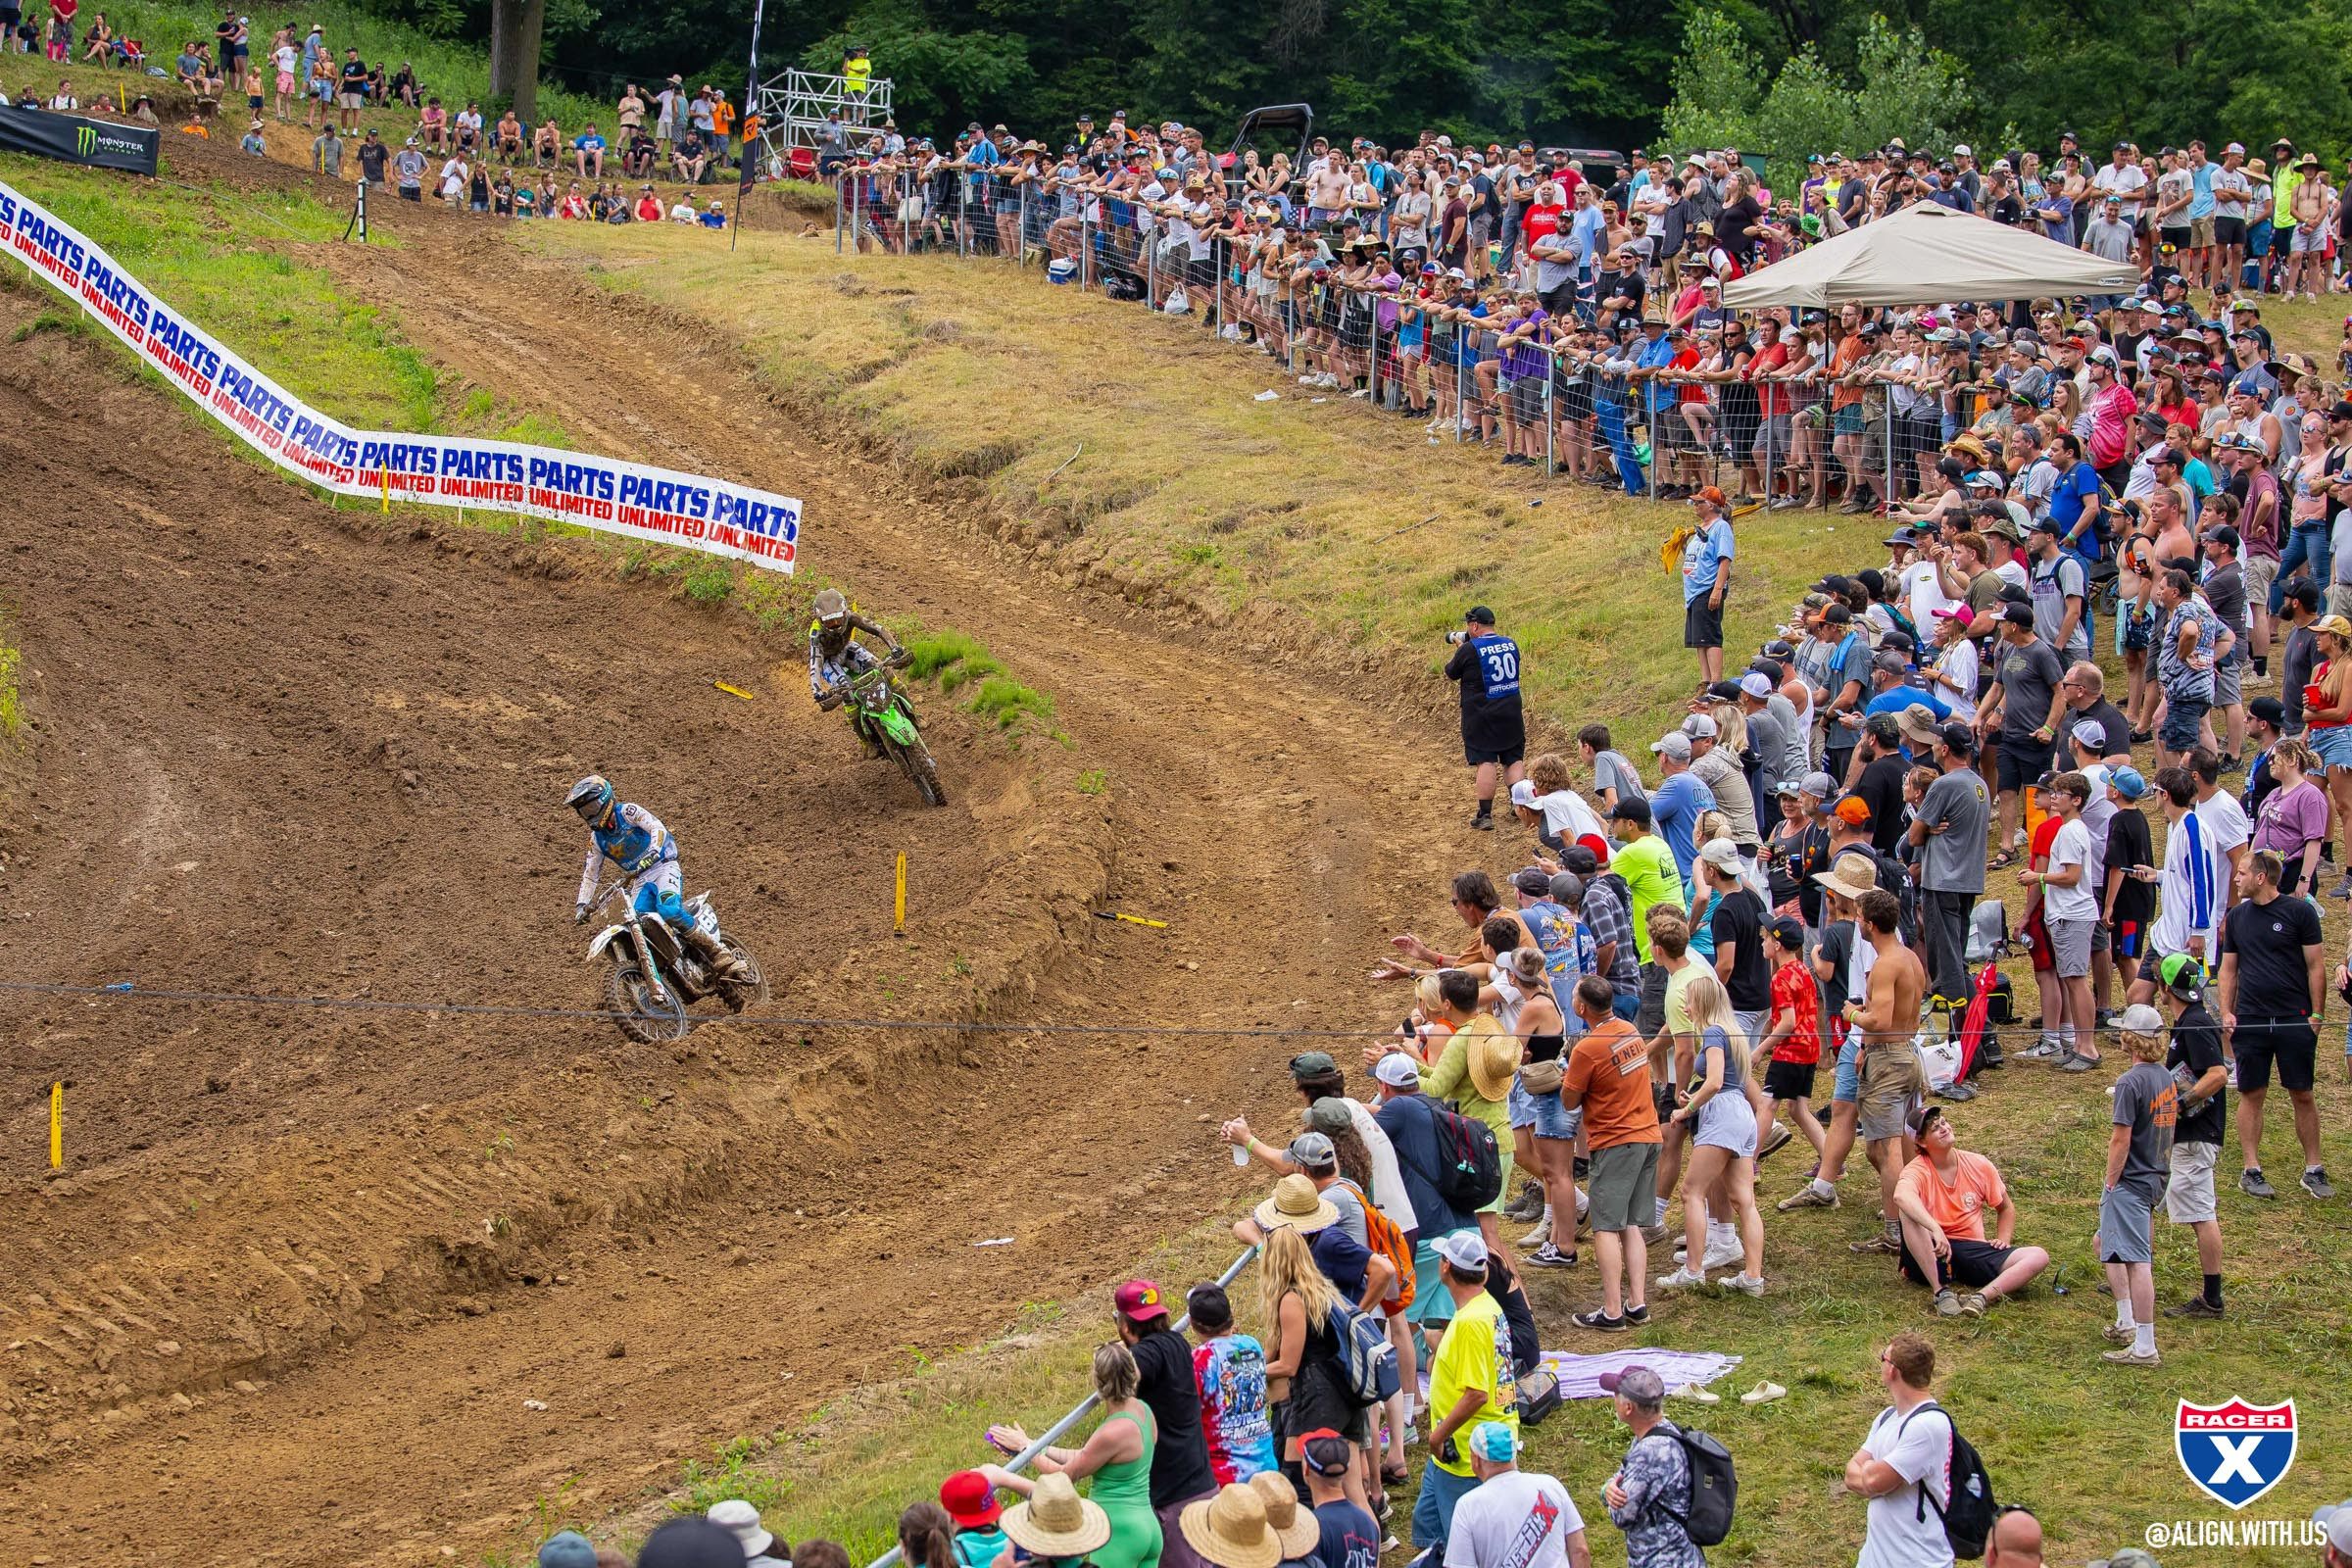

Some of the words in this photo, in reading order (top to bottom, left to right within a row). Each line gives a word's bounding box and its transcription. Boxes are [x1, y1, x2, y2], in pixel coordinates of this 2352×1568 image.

[97, 136, 144, 152] MONSTER
[17, 208, 84, 271] PARTS
[83, 256, 149, 326] PARTS
[150, 310, 220, 380] PARTS
[219, 365, 293, 432] PARTS
[290, 416, 358, 466] PARTS
[359, 442, 437, 473] PARTS
[441, 448, 523, 482] PARTS
[529, 458, 614, 500] PARTS
[619, 474, 710, 517] PARTS
[712, 492, 797, 541] PARTS
[15, 233, 78, 288] UNLIMITED
[81, 280, 143, 343] UNLIMITED
[147, 335, 211, 396] UNLIMITED
[213, 390, 282, 449] UNLIMITED
[282, 442, 355, 483] UNLIMITED
[440, 478, 523, 502] UNLIMITED
[529, 487, 612, 519] UNLIMITED
[617, 505, 705, 538] UNLIMITED
[709, 522, 795, 562] UNLIMITED
[1479, 642, 1516, 657] PRESS
[1488, 652, 1517, 682] 30
